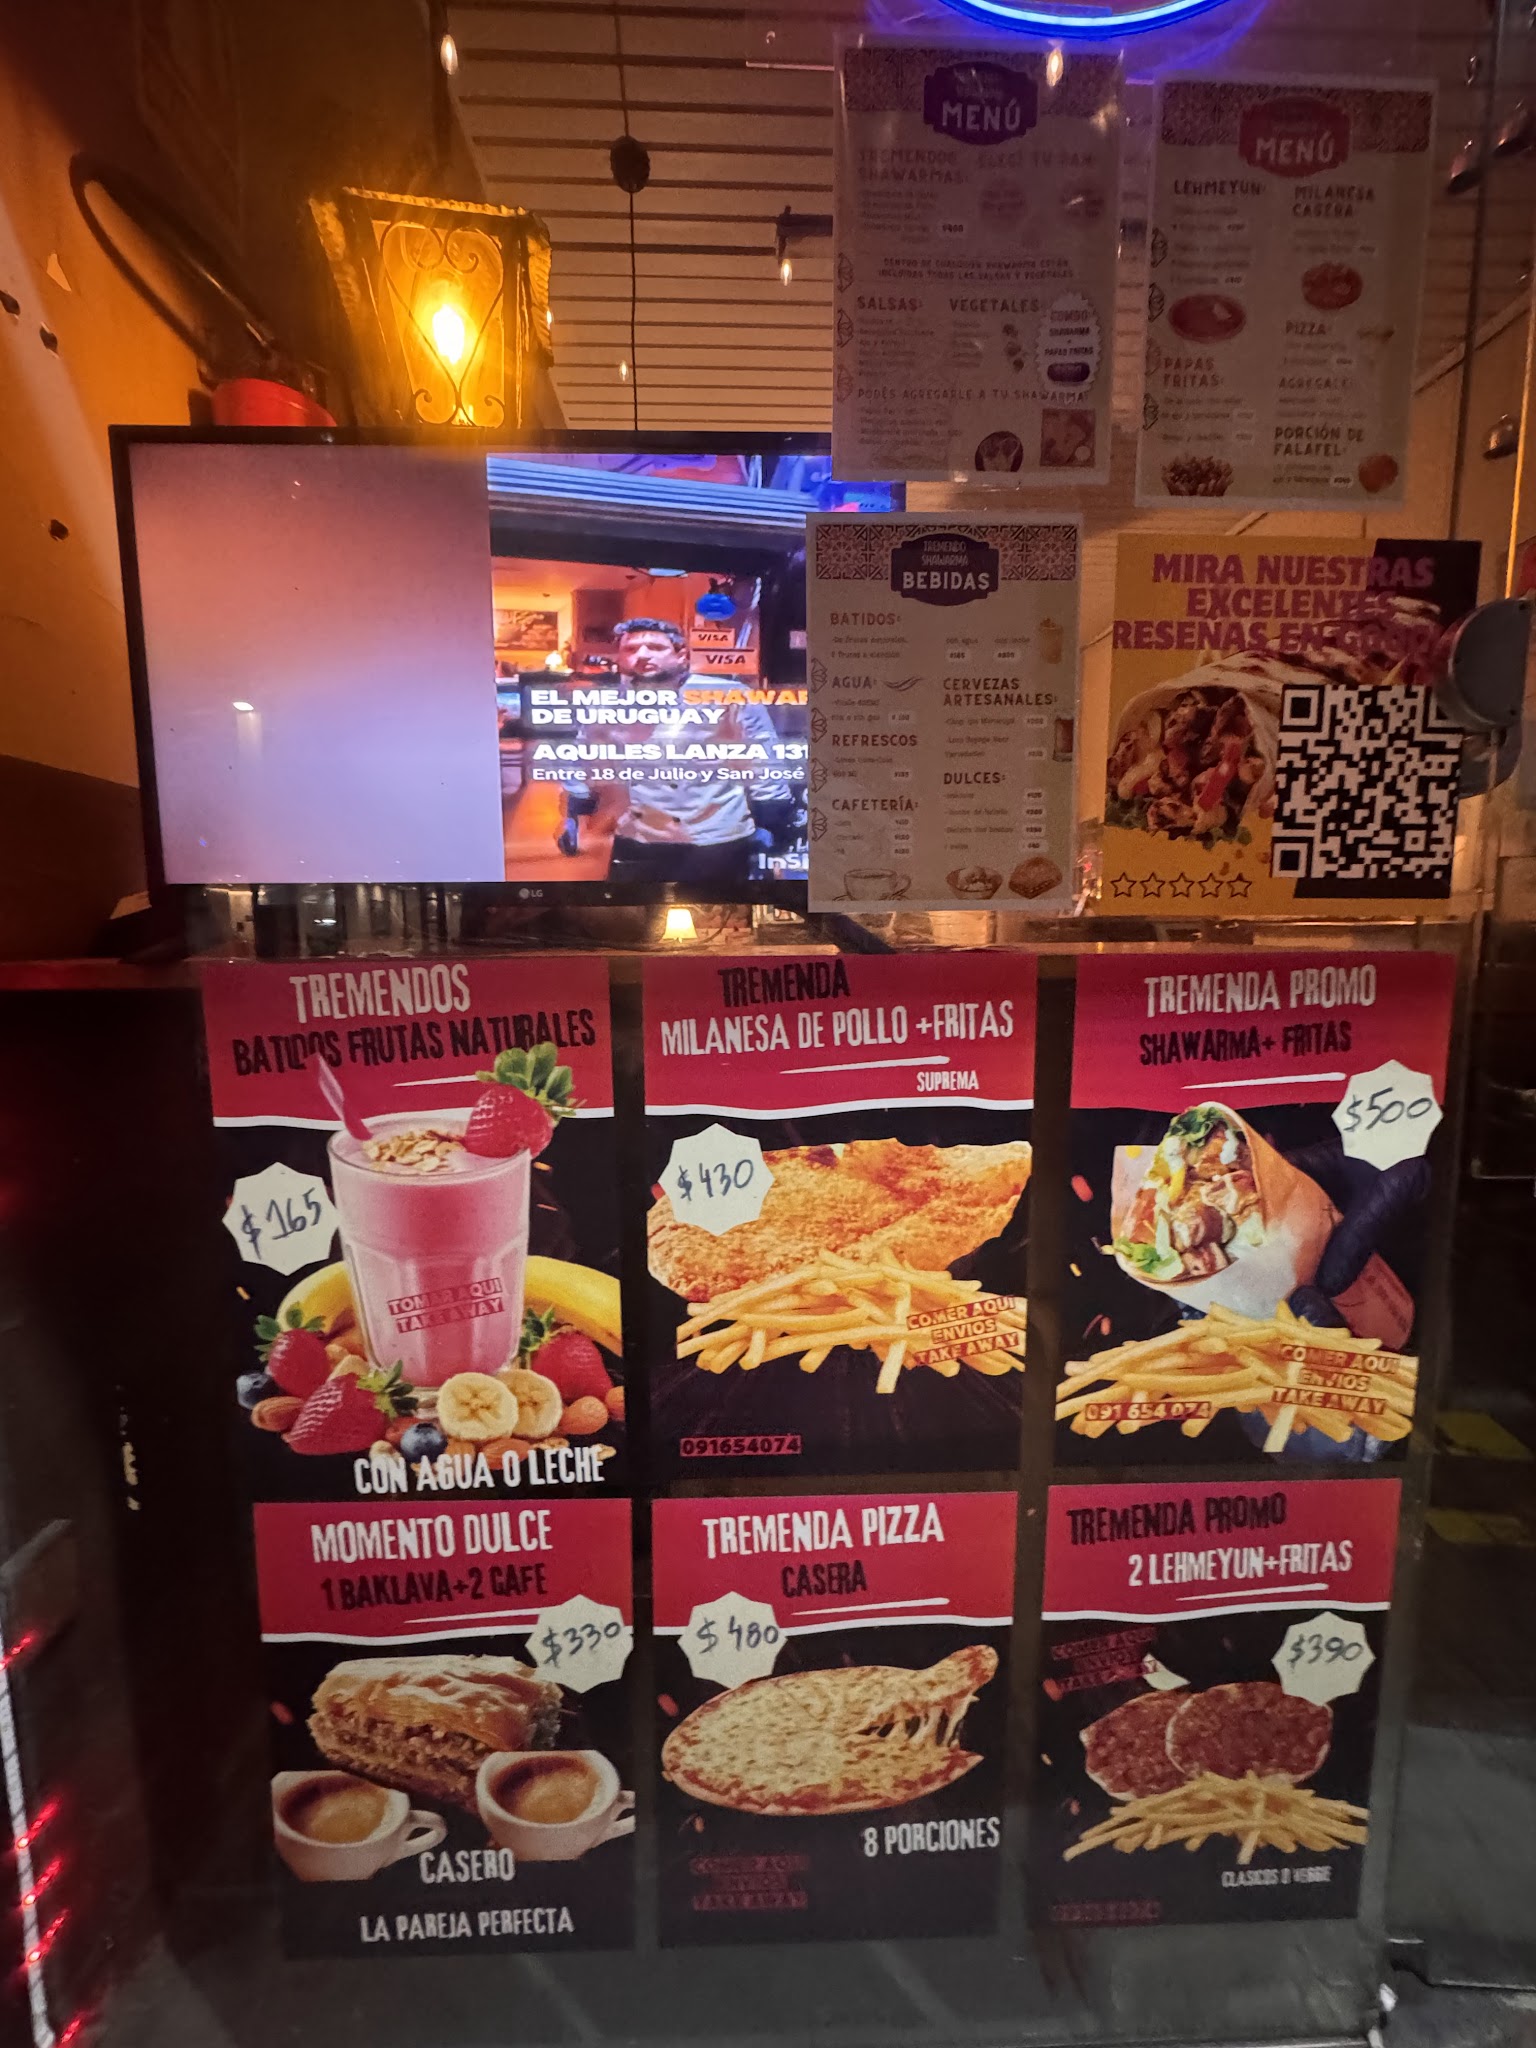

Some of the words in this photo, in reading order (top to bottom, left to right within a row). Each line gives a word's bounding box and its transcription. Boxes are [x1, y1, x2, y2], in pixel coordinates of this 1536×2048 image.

[941, 97, 1021, 132] MENÚ
[1256, 131, 1335, 163] MENÚ
[1274, 424, 1340, 440] PORCIÓN
[1347, 428, 1364, 442] DE
[902, 571, 990, 591] BEBIDAS
[1152, 553, 1246, 584] MIRA
[1256, 554, 1436, 588] NUESTRAS
[698, 634, 729, 642] VISA
[1279, 623, 1324, 654] EN
[705, 655, 746, 665] VISA
[530, 690, 568, 706] EL
[572, 690, 678, 706] MEJOR
[943, 678, 1019, 690] CERVEZAS
[531, 708, 572, 725] DE
[576, 708, 725, 725] URUGUAY
[532, 744, 663, 762] AQUILES
[666, 744, 768, 760] LANZA
[832, 734, 918, 747] REFRESCOS
[533, 768, 586, 781] Entre
[590, 768, 615, 781] 18
[618, 768, 644, 781] de
[648, 767, 697, 781] Julio
[701, 770, 716, 784] y
[717, 767, 753, 781] San
[758, 766, 805, 781] José
[943, 772, 1006, 785] DULCES:
[832, 796, 919, 812] CAFETERÍA:
[531, 889, 543, 898] LG
[289, 963, 471, 1024] TREMENDOS
[718, 959, 850, 1008] TREMENDA
[1144, 970, 1280, 1018] TREMENDA
[1289, 963, 1377, 1010] PROMO
[232, 1029, 342, 1076] BATIDOS
[348, 1021, 446, 1066] FRUTAS
[448, 1008, 597, 1058] NATURALES
[661, 1013, 789, 1056] MILANESA
[797, 1011, 825, 1050] DE
[832, 1005, 908, 1047] POLLO
[914, 1000, 1014, 1041] +FRITAS
[1282, 1019, 1353, 1058] FRITAS
[916, 1071, 980, 1092] SUPREMA
[1343, 1085, 1433, 1133] $500
[907, 1305, 969, 1330] COMER
[971, 1295, 1017, 1317] AQUI
[932, 1319, 996, 1343] ENVIOS
[916, 1343, 961, 1364] TAKE
[966, 1332, 1019, 1355] AWAY
[1281, 1345, 1348, 1367] COMER
[1086, 1403, 1122, 1420] 091
[1127, 1402, 1167, 1419] 654
[1170, 1402, 1211, 1418] 074
[1272, 1386, 1324, 1407] TAKE
[1326, 1394, 1386, 1415] AWAY
[682, 1436, 800, 1456] 091654074
[354, 1455, 408, 1494] CON
[416, 1454, 495, 1491] AGUA
[503, 1452, 521, 1487] O
[528, 1446, 605, 1486] LECHE
[702, 1509, 854, 1559] TREMENDA
[861, 1502, 945, 1548] PIZZA
[1066, 1498, 1195, 1546] TREMENDA
[1204, 1492, 1287, 1534] PROMO
[310, 1514, 456, 1564] MOMENTO
[463, 1509, 553, 1555] DULCE
[781, 1560, 868, 1599] CASERA
[1128, 1554, 1143, 1587] 2
[541, 1621, 622, 1669] $330
[1287, 1633, 1363, 1673] $390
[864, 1827, 879, 1857] 8
[884, 1817, 1000, 1855] PORCIONES
[419, 1848, 516, 1884] CASERO
[360, 1915, 391, 1943] LA
[395, 1912, 472, 1941] PAREJA
[477, 1906, 576, 1937] PERFECTA
